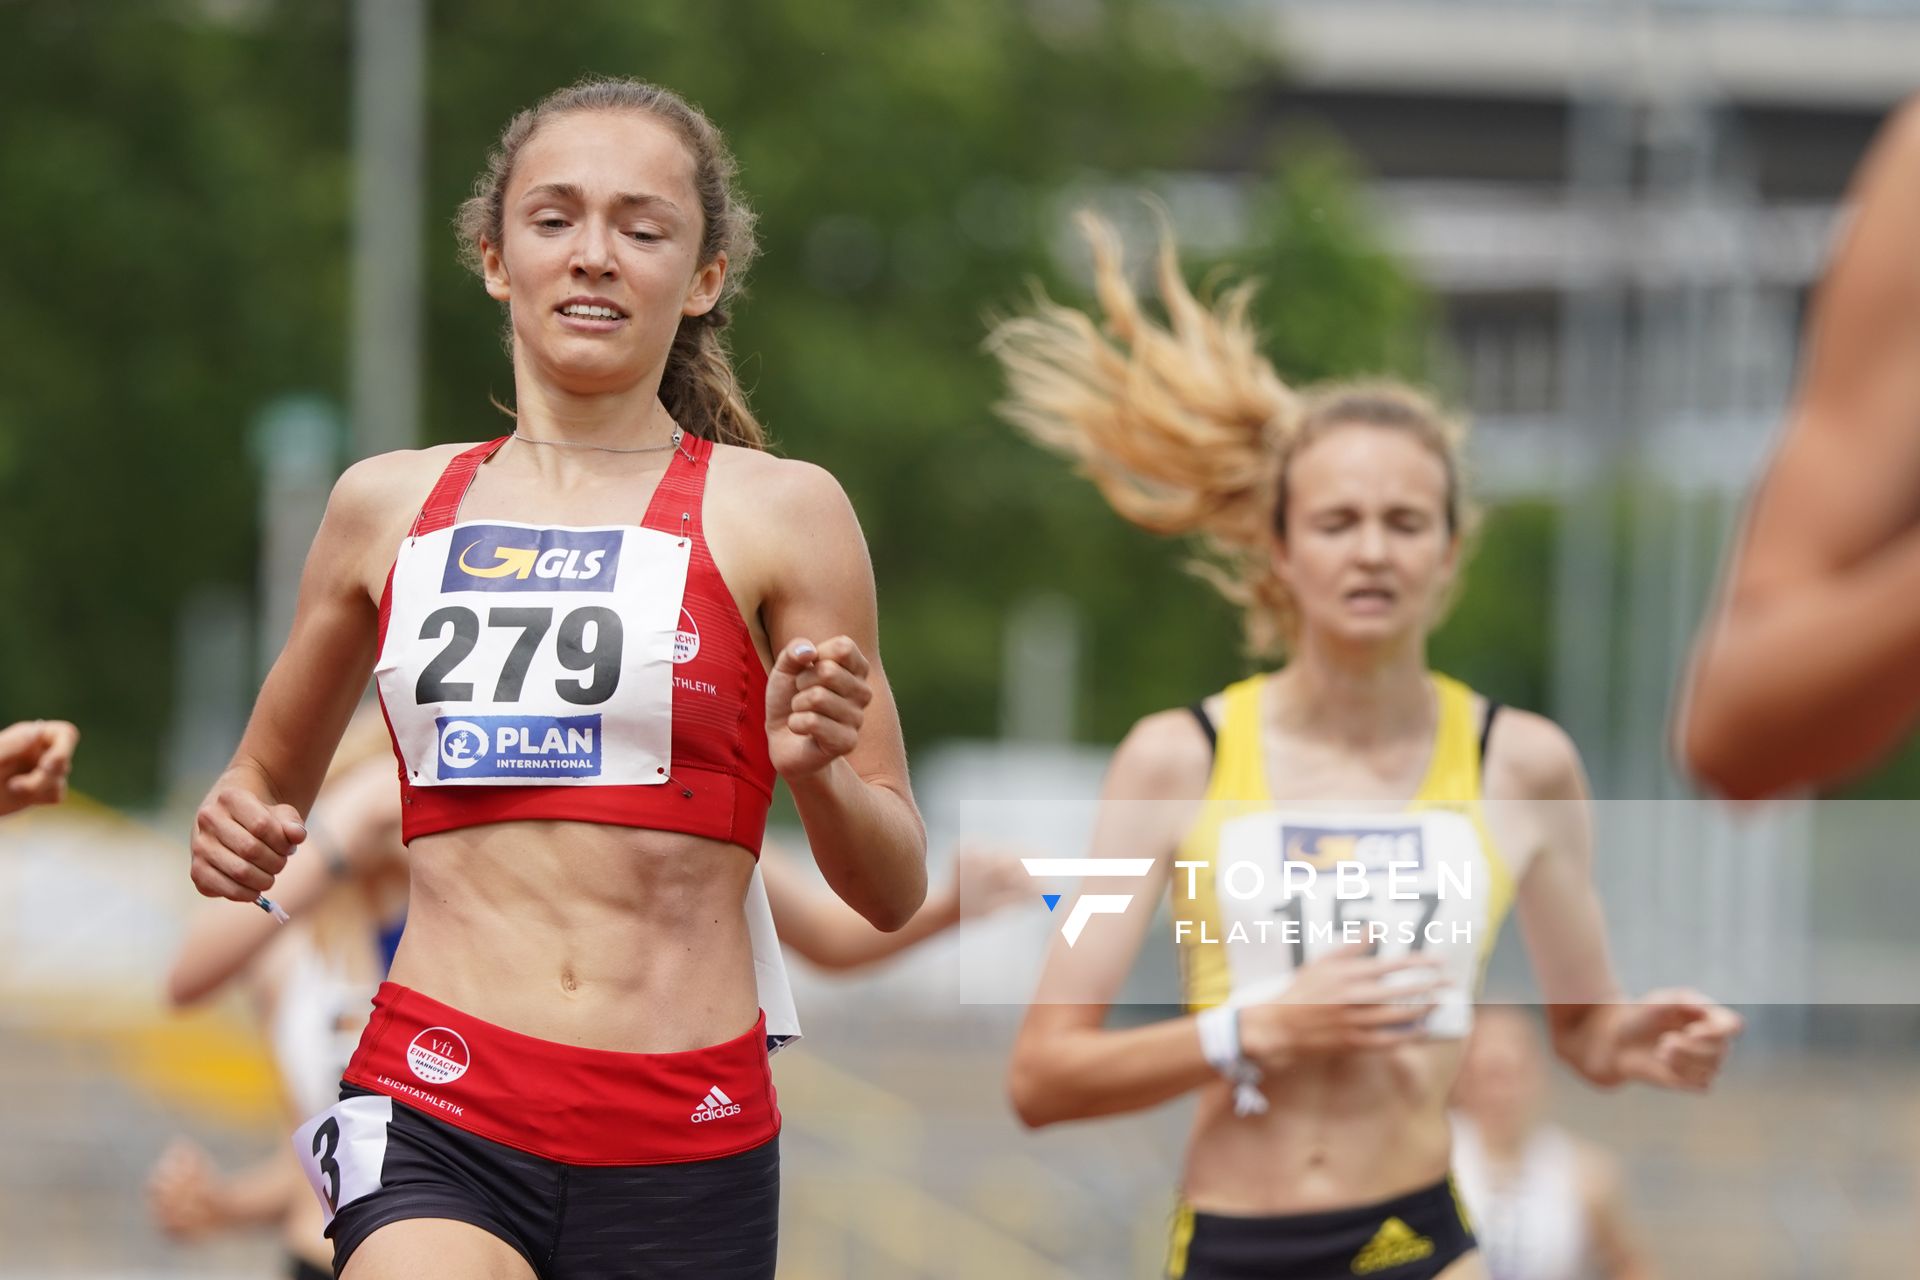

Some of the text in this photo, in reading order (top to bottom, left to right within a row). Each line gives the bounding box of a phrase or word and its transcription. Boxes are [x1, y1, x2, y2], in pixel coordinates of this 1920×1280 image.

[535, 548, 606, 579] GLS
[416, 606, 624, 706] 279
[497, 727, 593, 755] PLAN
[497, 759, 593, 769] INTERNATIONAL
[410, 1047, 463, 1075] EINTRACHT
[431, 1038, 455, 1059] VfL
[415, 1059, 449, 1077] HANNOVER
[377, 1074, 464, 1117] LEICHTATHLETIK
[690, 1103, 741, 1123] adidas
[312, 1115, 341, 1216] 3
